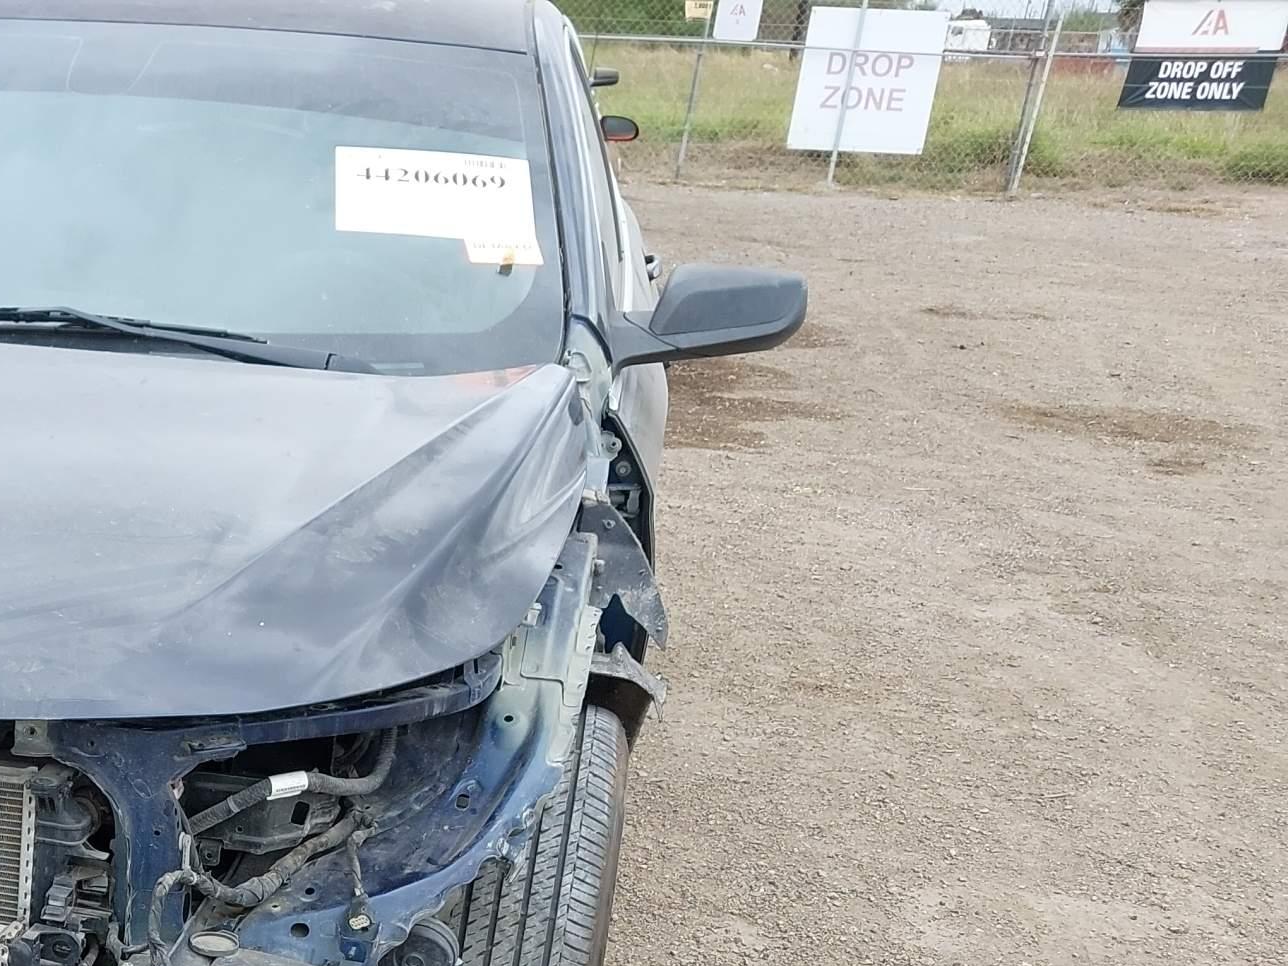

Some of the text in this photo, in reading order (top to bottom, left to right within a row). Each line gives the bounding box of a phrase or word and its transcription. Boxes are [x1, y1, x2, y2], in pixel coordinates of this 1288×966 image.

[826, 51, 915, 78] DROP
[1158, 60, 1246, 79] DROP OFF
[819, 84, 907, 112] ZONE
[1144, 81, 1246, 100] ZONE ONLY
[356, 166, 506, 189] 44206069
